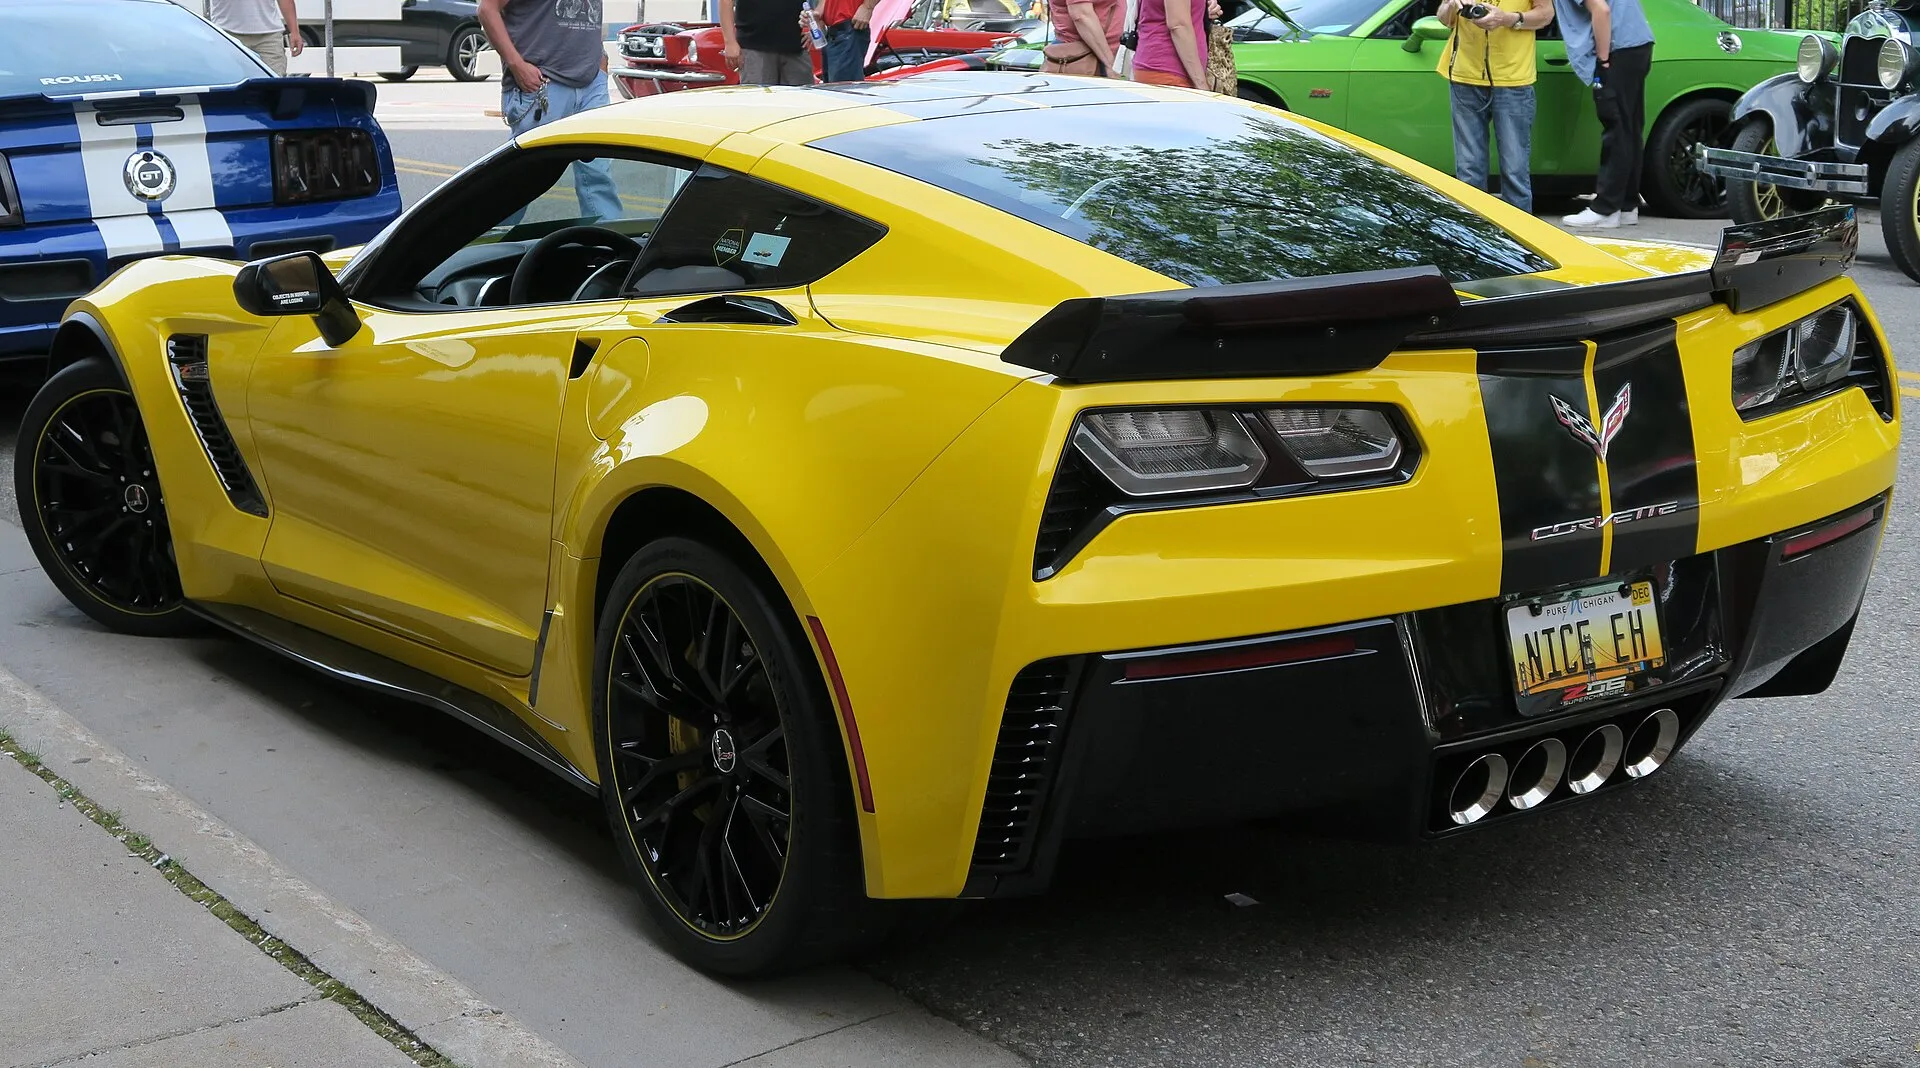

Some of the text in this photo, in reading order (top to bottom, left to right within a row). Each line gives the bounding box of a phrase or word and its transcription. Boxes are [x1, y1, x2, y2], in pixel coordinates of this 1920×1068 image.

[40, 73, 123, 85] ROUSH
[140, 170, 161, 181] GT
[716, 245, 737, 254] MEMBER
[719, 238, 740, 247] NATIONAL
[1530, 500, 1678, 542] CORVETTE
[1632, 586, 1650, 600] DEC
[1546, 595, 1615, 618] PURE MICHIGAN
[1525, 608, 1647, 683] NICE EH
[1562, 675, 1627, 701] Z06
[1561, 687, 1625, 706] SUPERCHARGED
